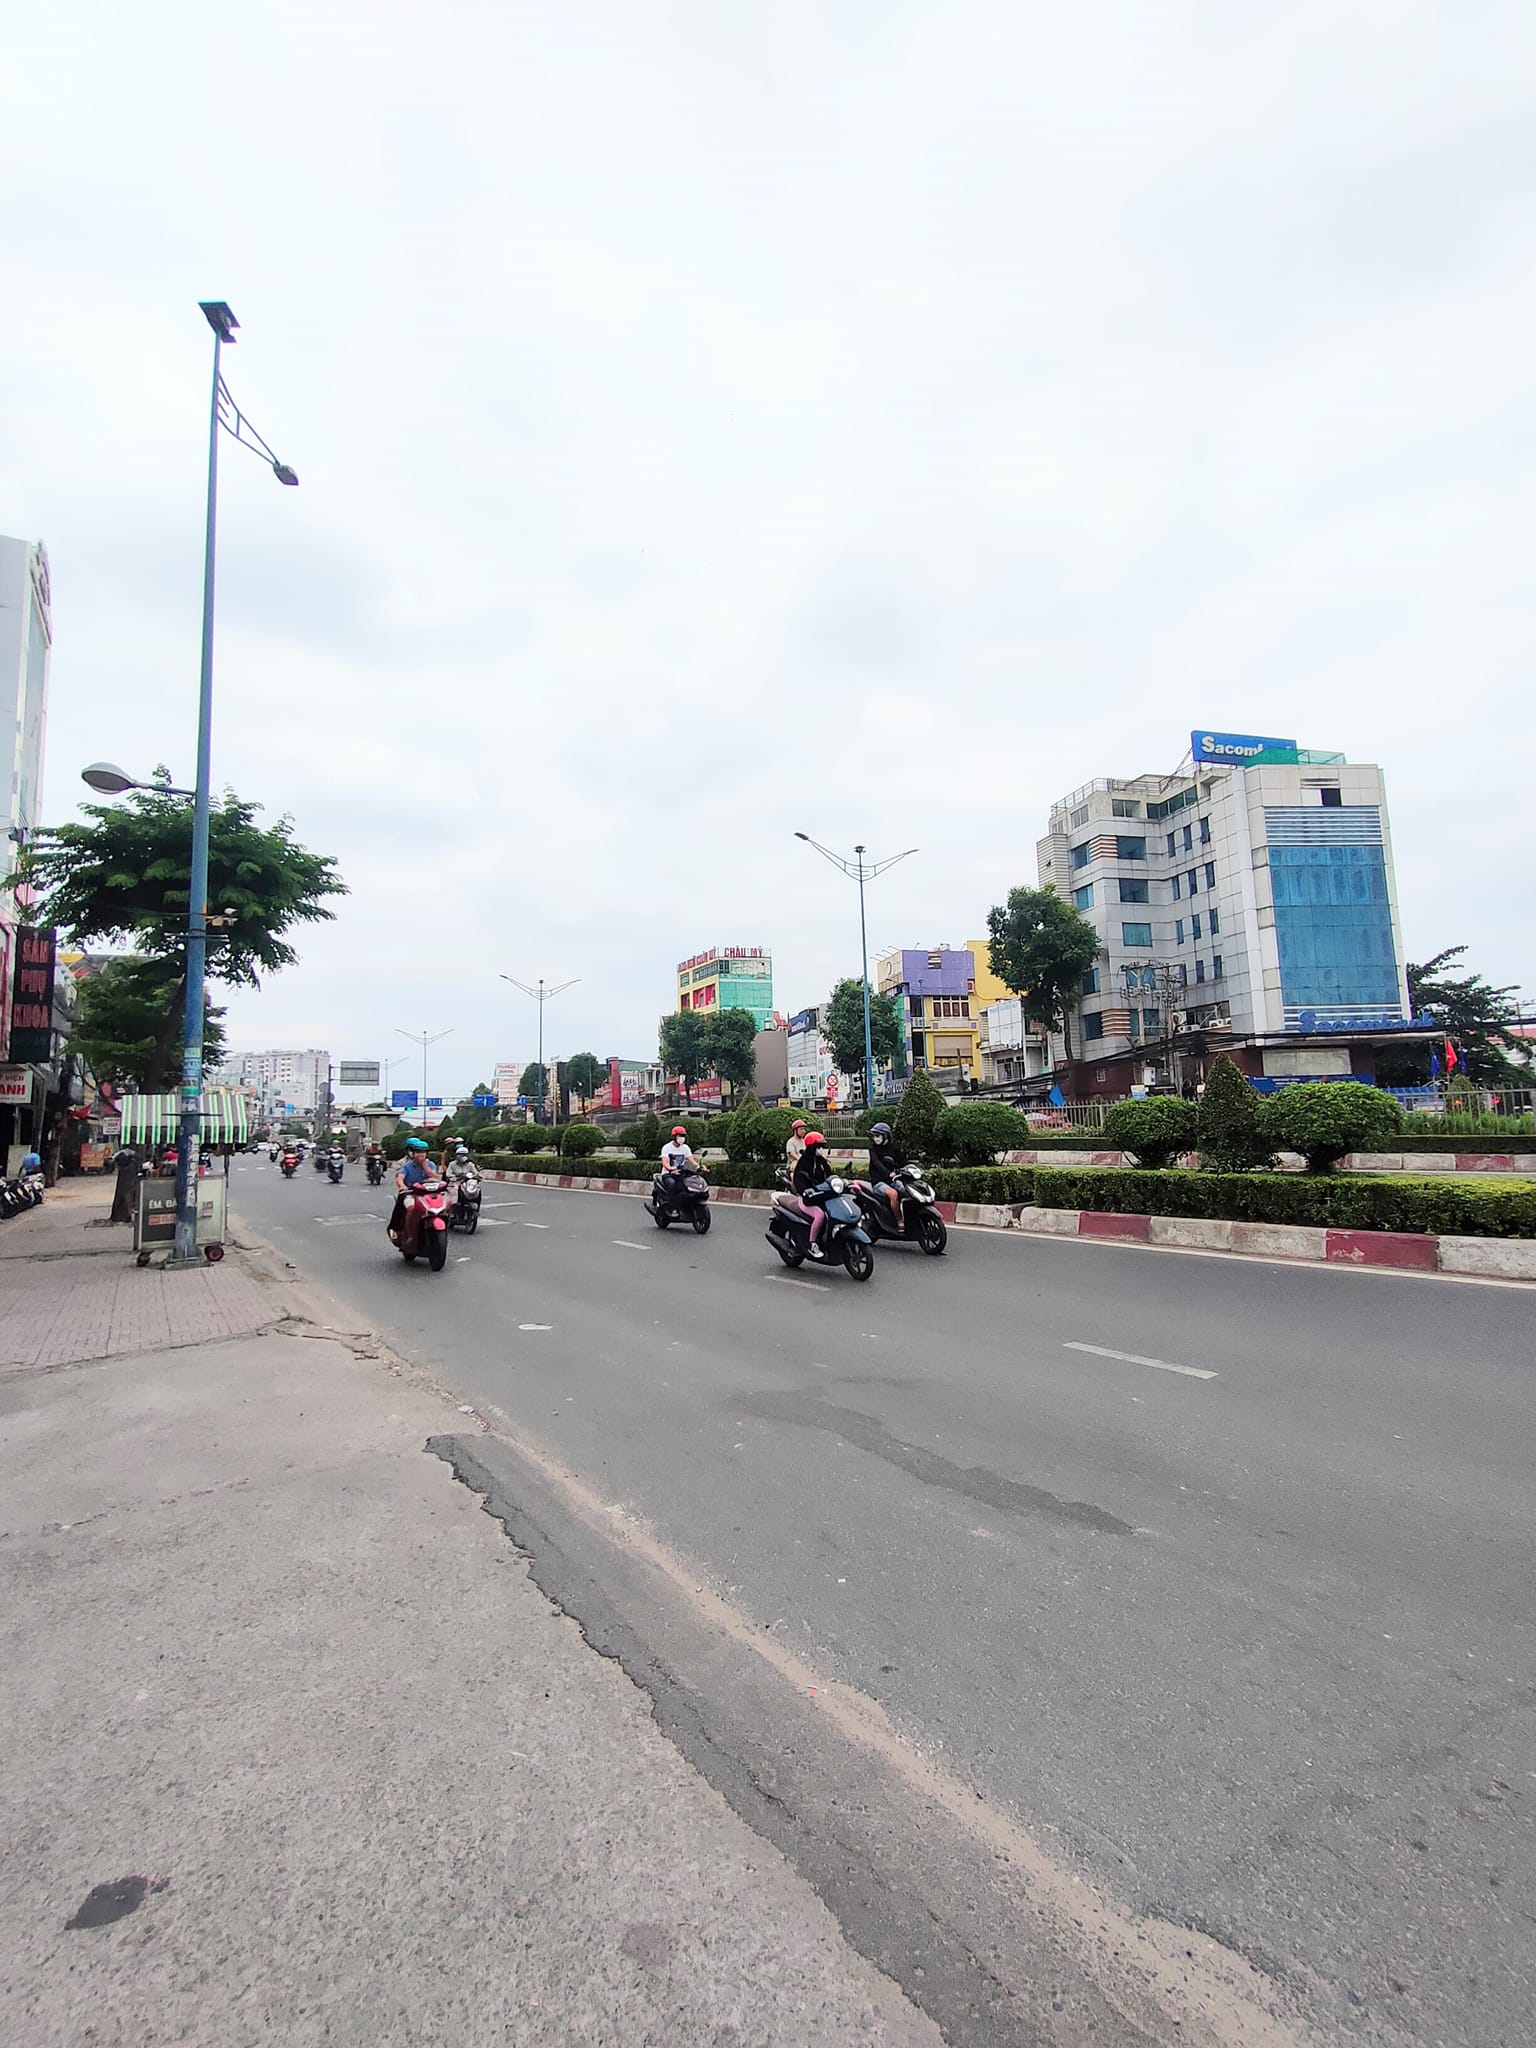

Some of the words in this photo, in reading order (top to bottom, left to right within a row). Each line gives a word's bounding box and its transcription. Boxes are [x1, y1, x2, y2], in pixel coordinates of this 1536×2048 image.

[22, 931, 49, 964] SẢN
[21, 968, 48, 1001] PHỤ
[13, 1003, 49, 1029] KHOA
